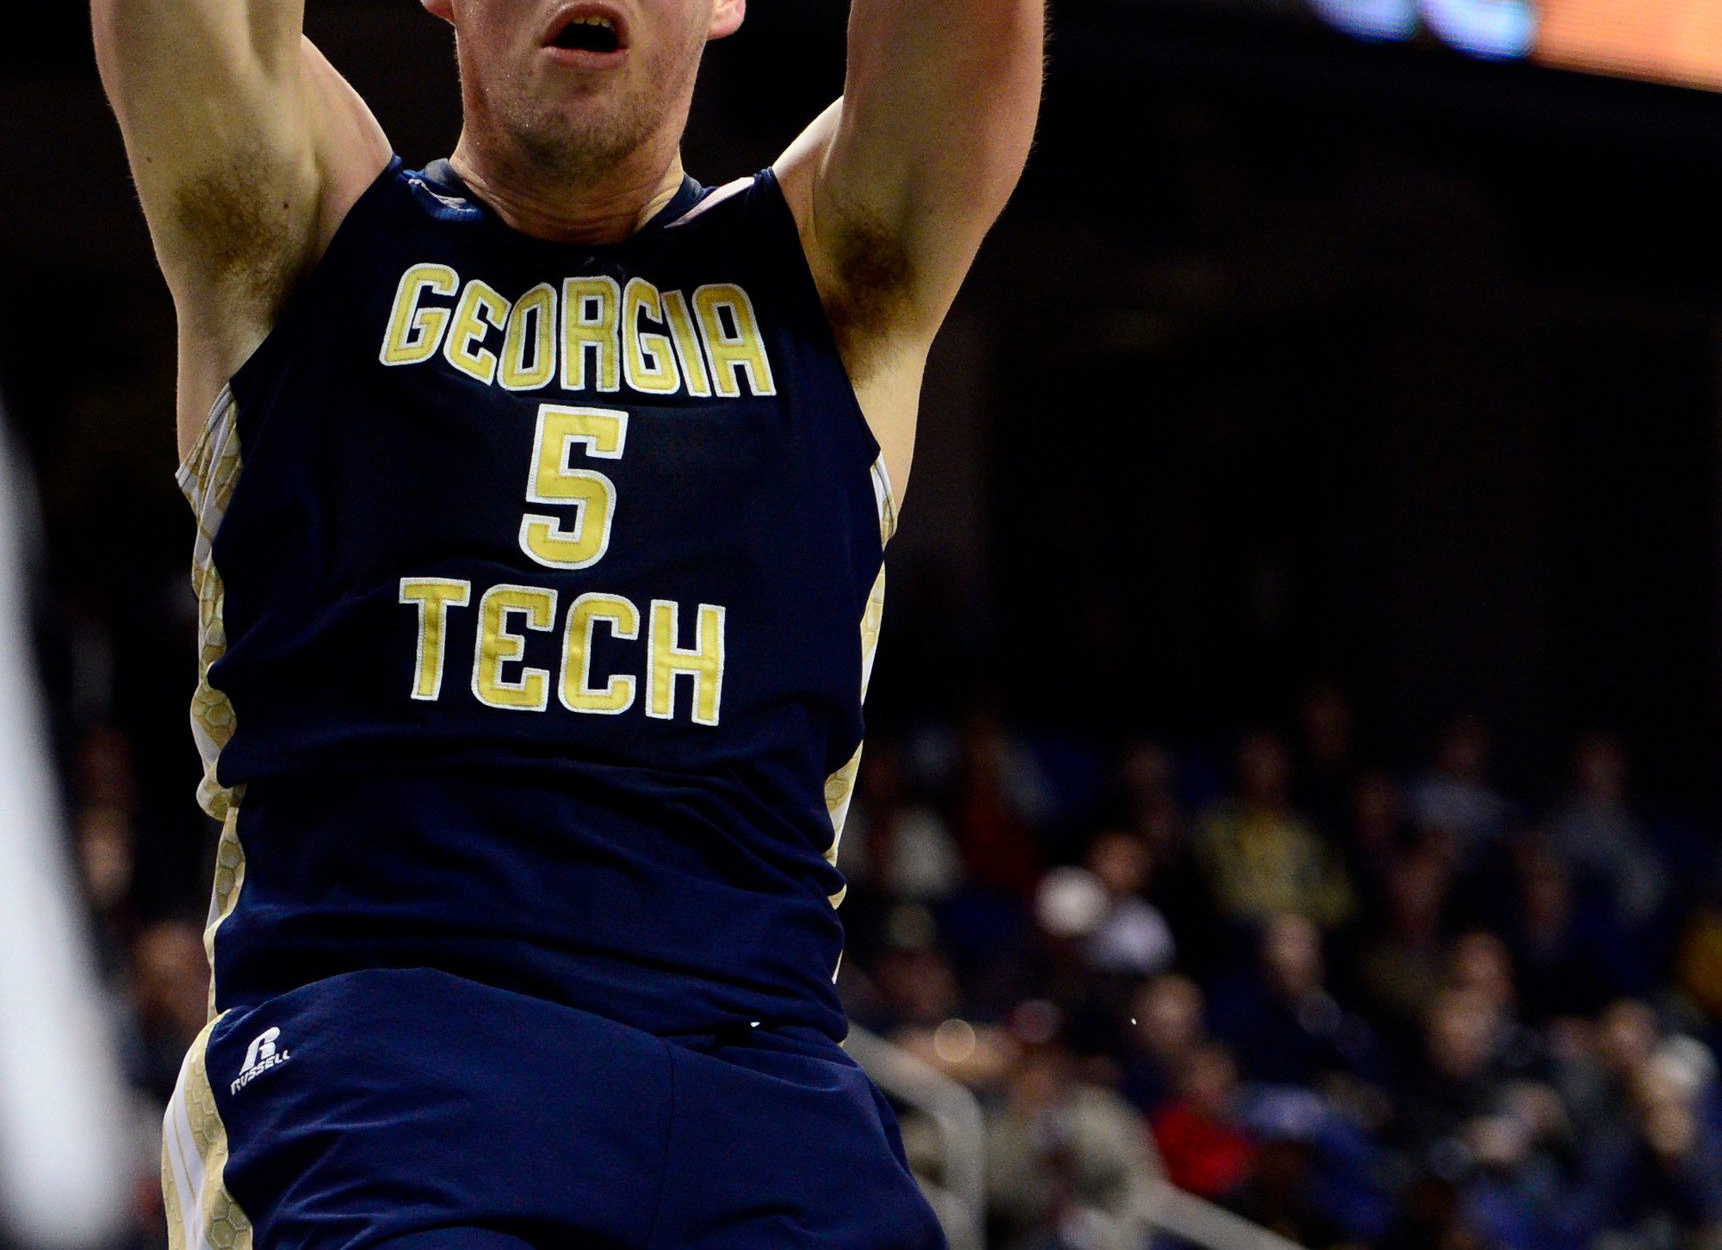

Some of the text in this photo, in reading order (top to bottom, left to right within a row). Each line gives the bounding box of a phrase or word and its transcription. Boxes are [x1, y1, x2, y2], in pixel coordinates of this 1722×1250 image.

[379, 262, 777, 398] GEORGIA
[518, 403, 629, 570] 5
[398, 577, 726, 727] TECH
[230, 1049, 291, 1096] RUSSELL
